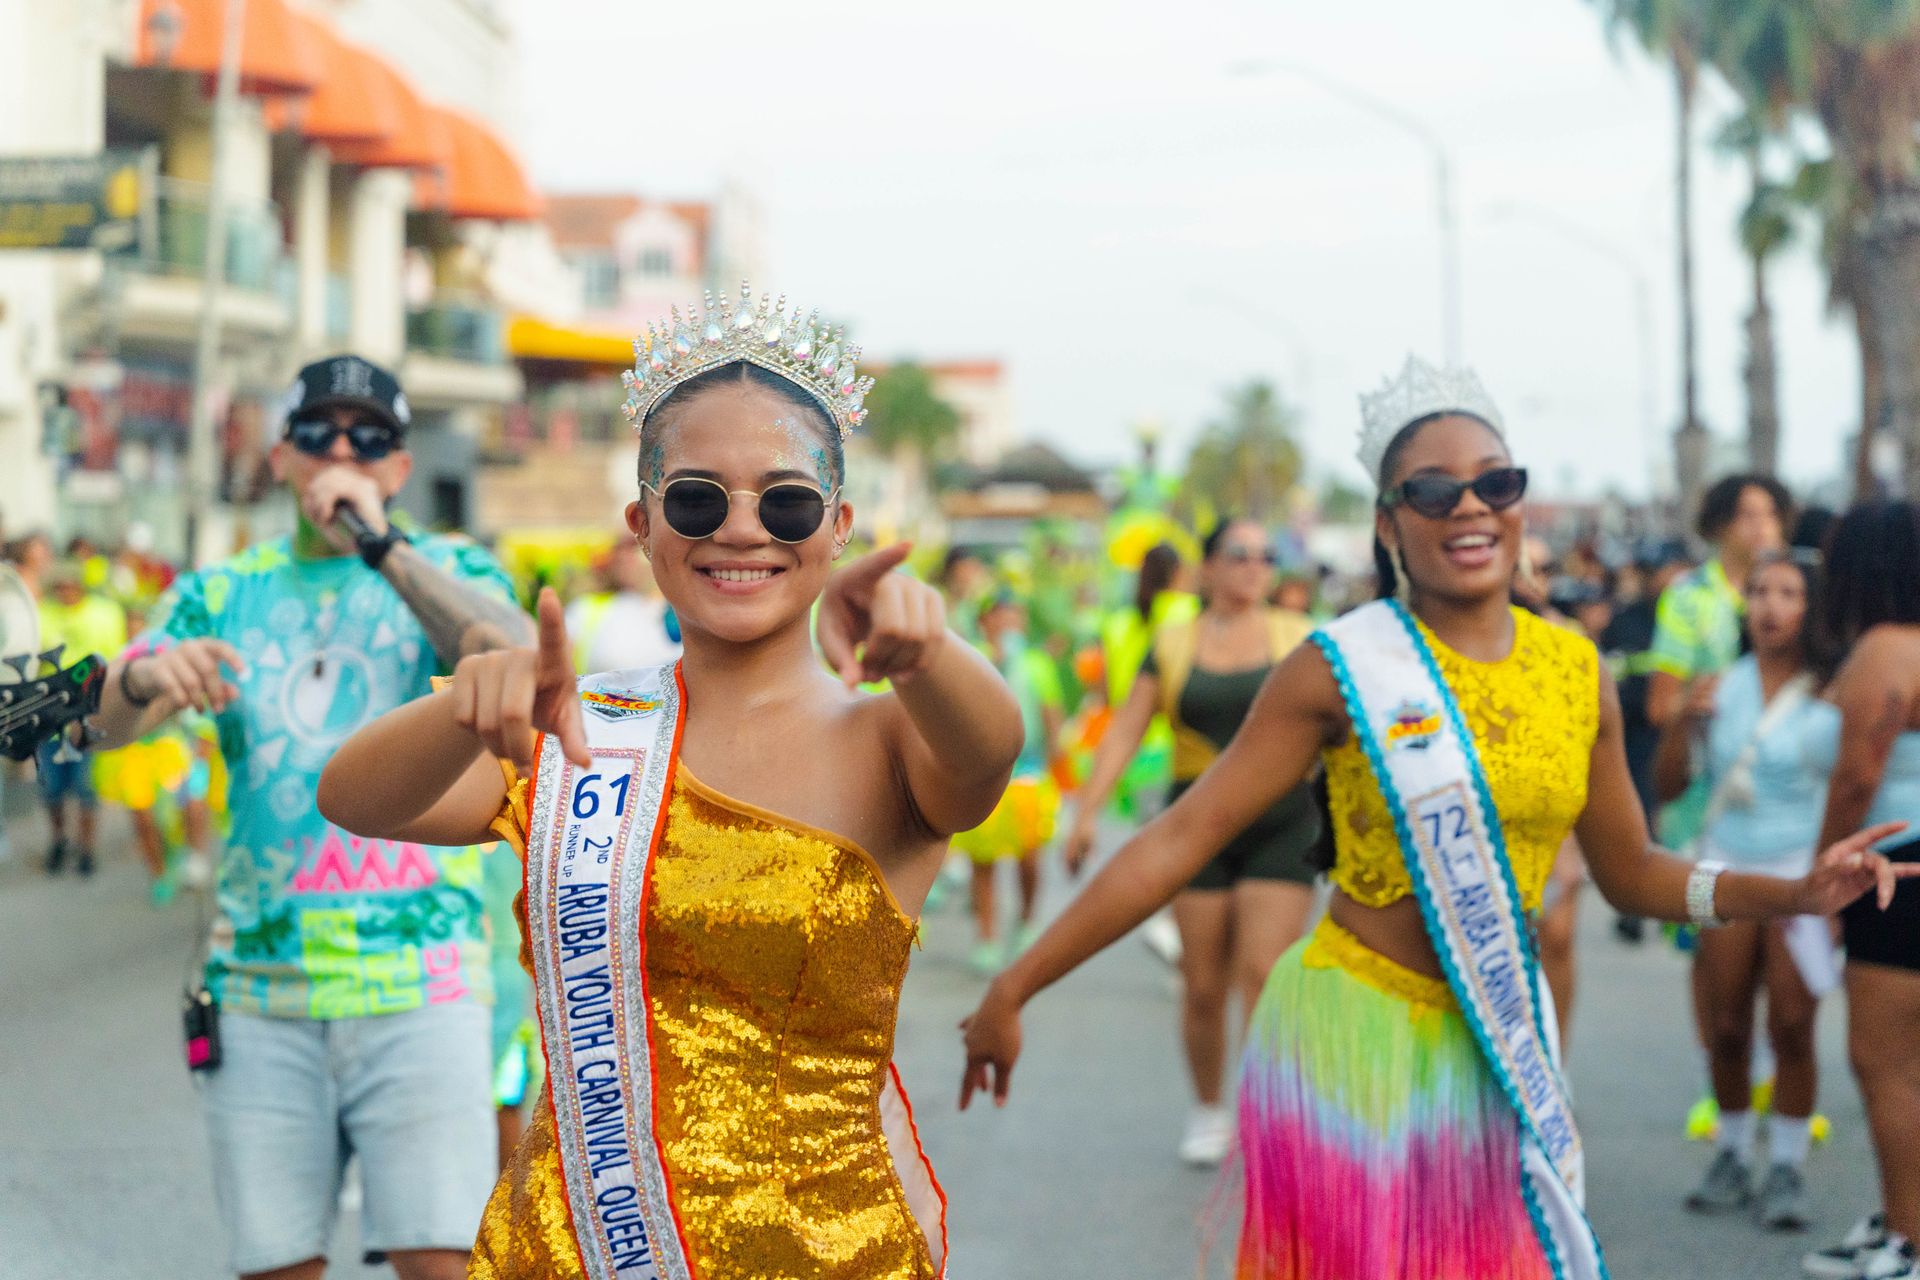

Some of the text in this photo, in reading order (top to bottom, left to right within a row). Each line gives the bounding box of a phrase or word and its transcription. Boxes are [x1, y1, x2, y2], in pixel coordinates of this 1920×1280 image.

[572, 773, 631, 820] 61
[583, 835, 613, 865] 2ND
[1420, 804, 1473, 847] 72
[562, 824, 581, 879] RUNNER UP
[1450, 882, 1502, 952] ARUBA
[558, 883, 652, 1271] ARUBA YOUTH CARNIVAL QUEEN
